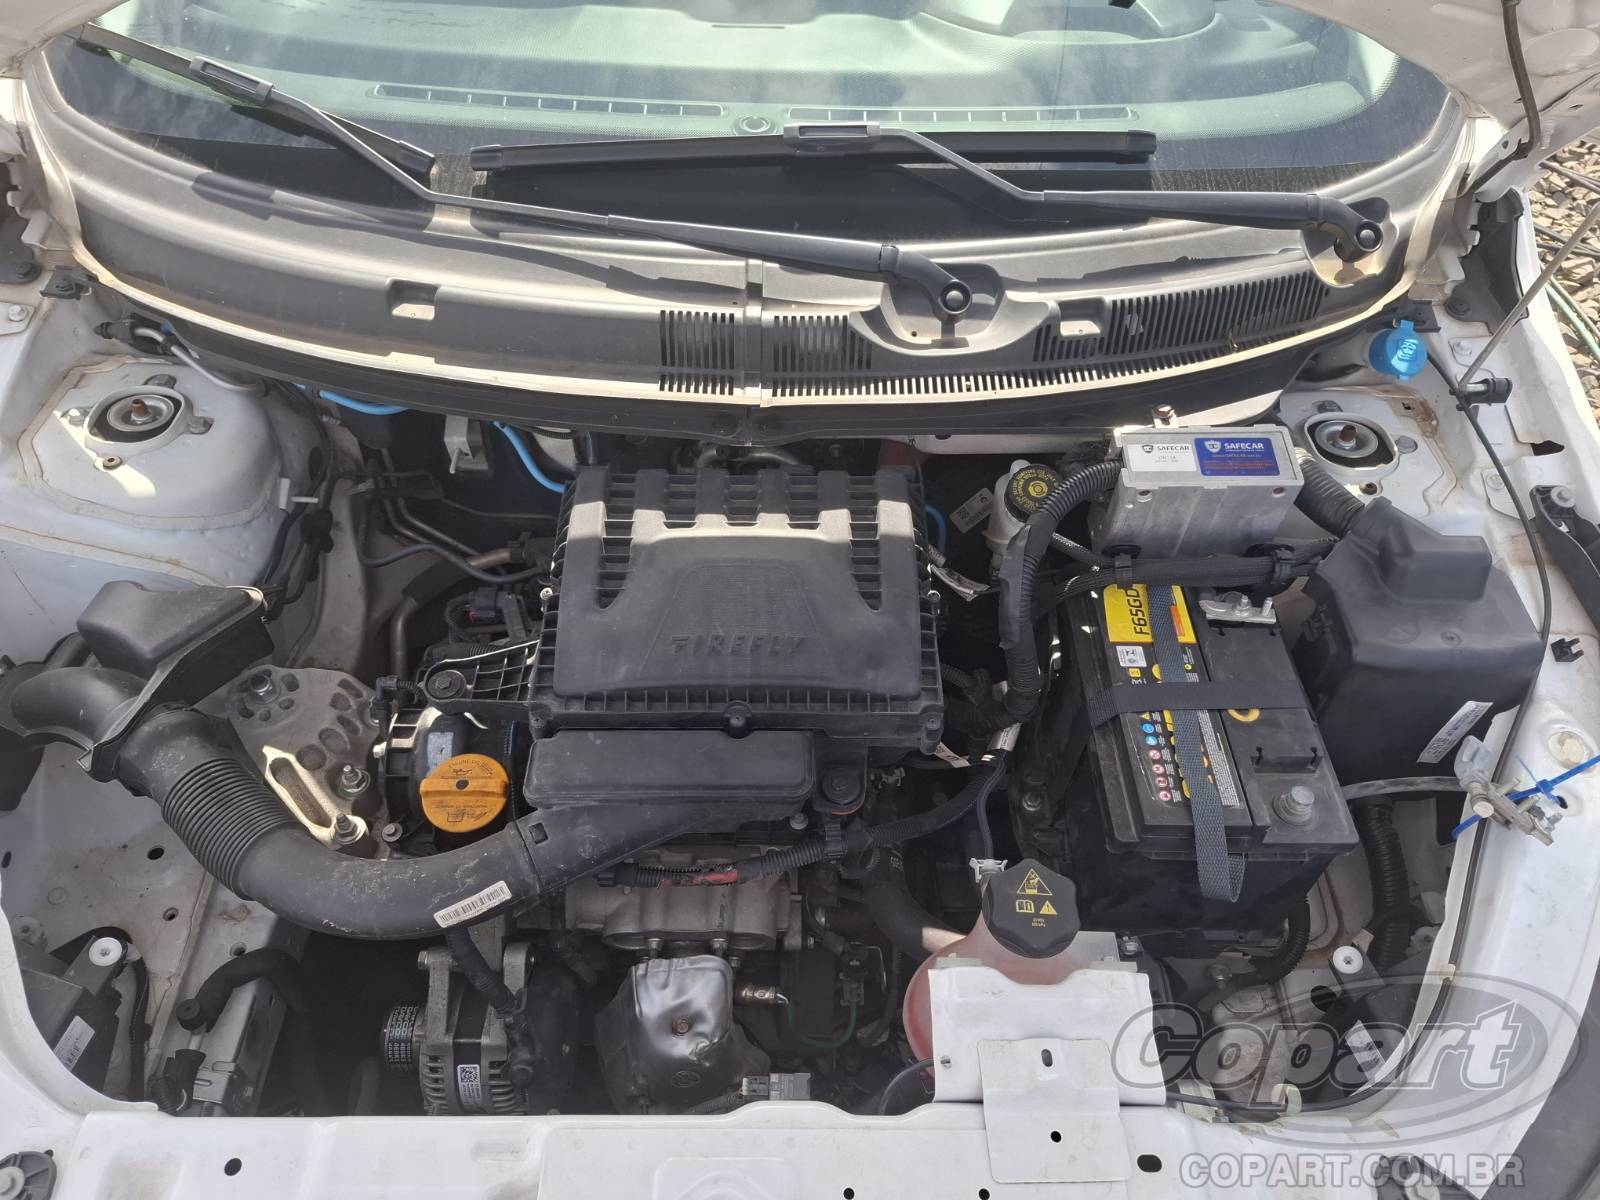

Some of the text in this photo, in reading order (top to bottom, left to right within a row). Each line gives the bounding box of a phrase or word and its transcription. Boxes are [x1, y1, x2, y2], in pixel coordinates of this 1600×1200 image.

[1224, 442, 1264, 450] SAFECAR
[1125, 587, 1150, 636] F65GD
[671, 634, 806, 657] FIREFLY
